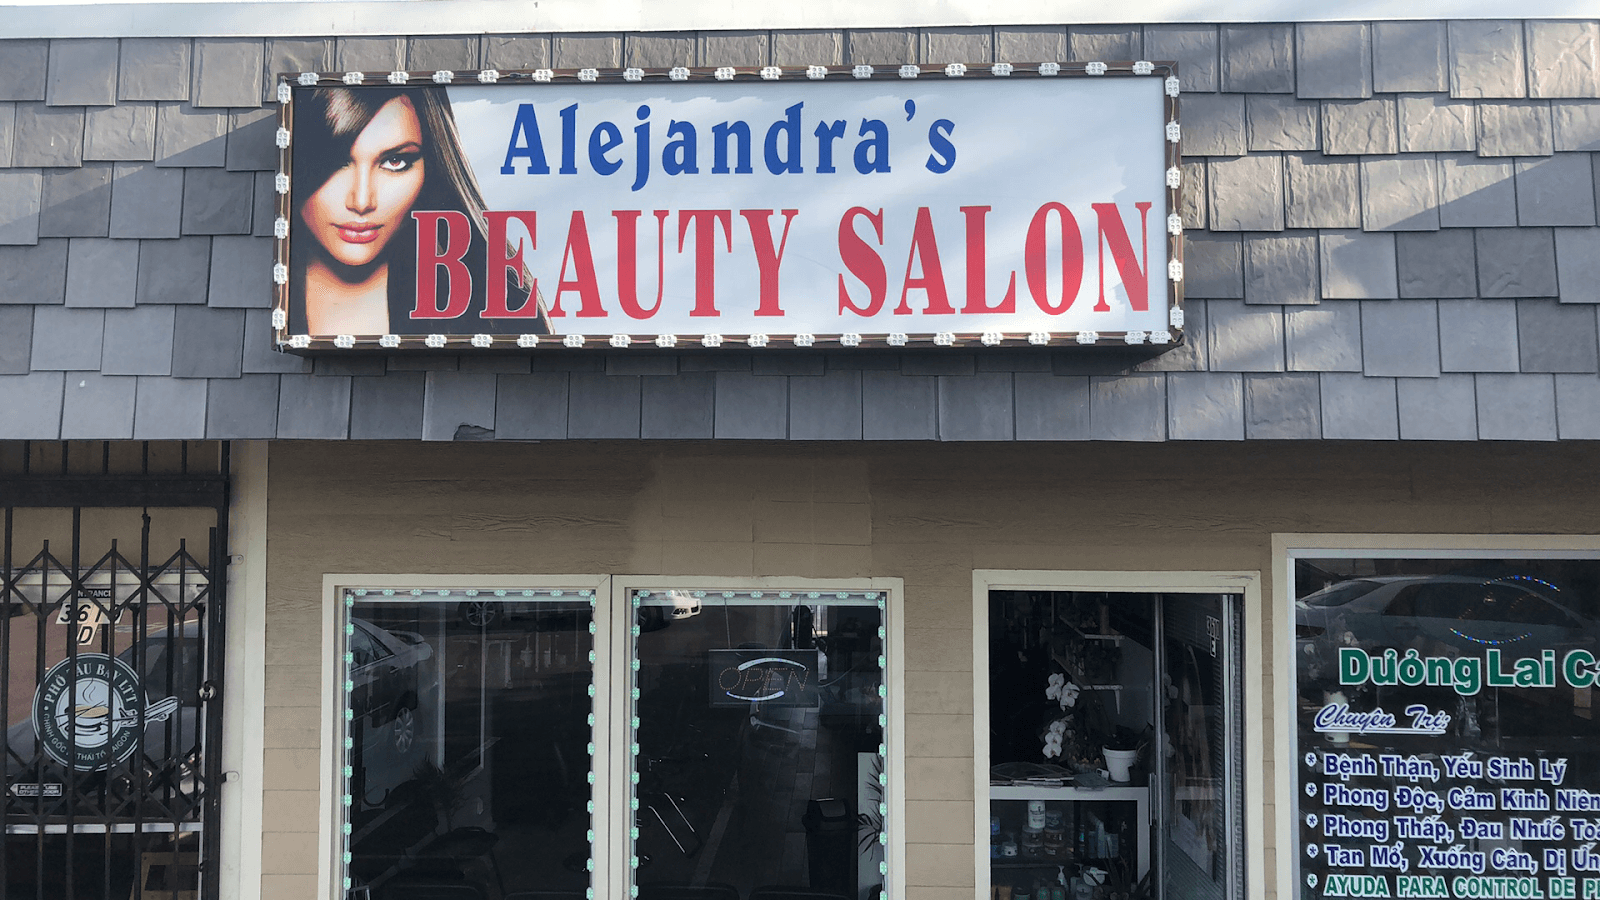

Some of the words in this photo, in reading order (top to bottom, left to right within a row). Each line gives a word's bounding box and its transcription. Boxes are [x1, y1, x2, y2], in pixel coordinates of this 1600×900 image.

[499, 98, 957, 192] Alejandra's
[408, 209, 799, 320] BEAUTY
[837, 201, 1153, 318] SALON
[77, 625, 93, 644] D
[719, 666, 810, 692] OPEN
[1486, 648, 1556, 687] Lai
[1563, 649, 1600, 688] C
[118, 680, 138, 703] LTT
[1314, 702, 1397, 732] Chuyên
[110, 730, 131, 754] AIGON
[1324, 753, 1377, 781] Bệnh
[1379, 754, 1440, 783] Thận,
[1441, 752, 1483, 778] Yếu
[1487, 757, 1535, 780] Sinh
[1540, 758, 1568, 785] Lý
[1324, 783, 1389, 811] Phong
[1394, 786, 1445, 814] Độc,
[1448, 785, 1496, 810] Cảm
[1501, 788, 1550, 811] Kinh
[1555, 788, 1600, 811] Niên
[1324, 814, 1389, 842] Phong
[1394, 815, 1455, 844] Thấp,
[1459, 817, 1503, 839] Đau
[1570, 818, 1600, 840] To
[1324, 844, 1364, 866] Tan
[1418, 844, 1485, 874] Xuống
[1491, 847, 1538, 875] Cân,
[1543, 848, 1567, 876] Dị
[1323, 874, 1391, 897] AYUDA
[1396, 875, 1449, 898] PARA
[1453, 876, 1544, 899] CONTROL
[1548, 877, 1576, 899] DE
